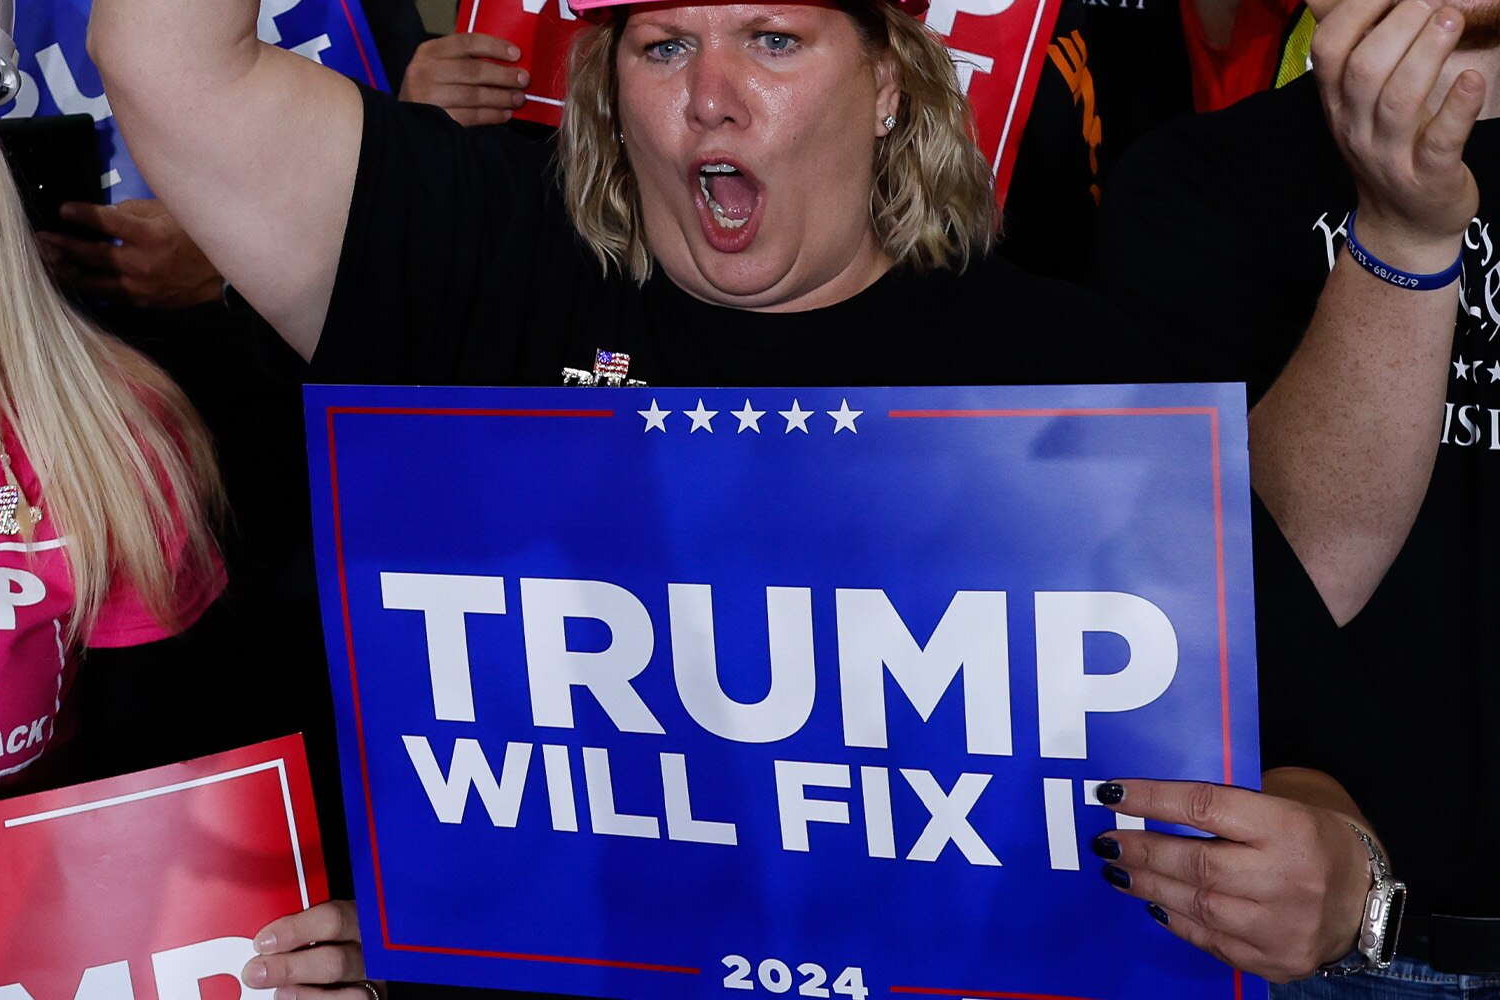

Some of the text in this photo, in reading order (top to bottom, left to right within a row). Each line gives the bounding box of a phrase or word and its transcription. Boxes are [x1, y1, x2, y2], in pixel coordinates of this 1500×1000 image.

[1373, 265, 1419, 288] 6/27/89
[380, 571, 1179, 759] TRUMP
[401, 735, 738, 846] WILL
[774, 760, 1003, 866] FIX
[721, 954, 869, 1000] 2024
